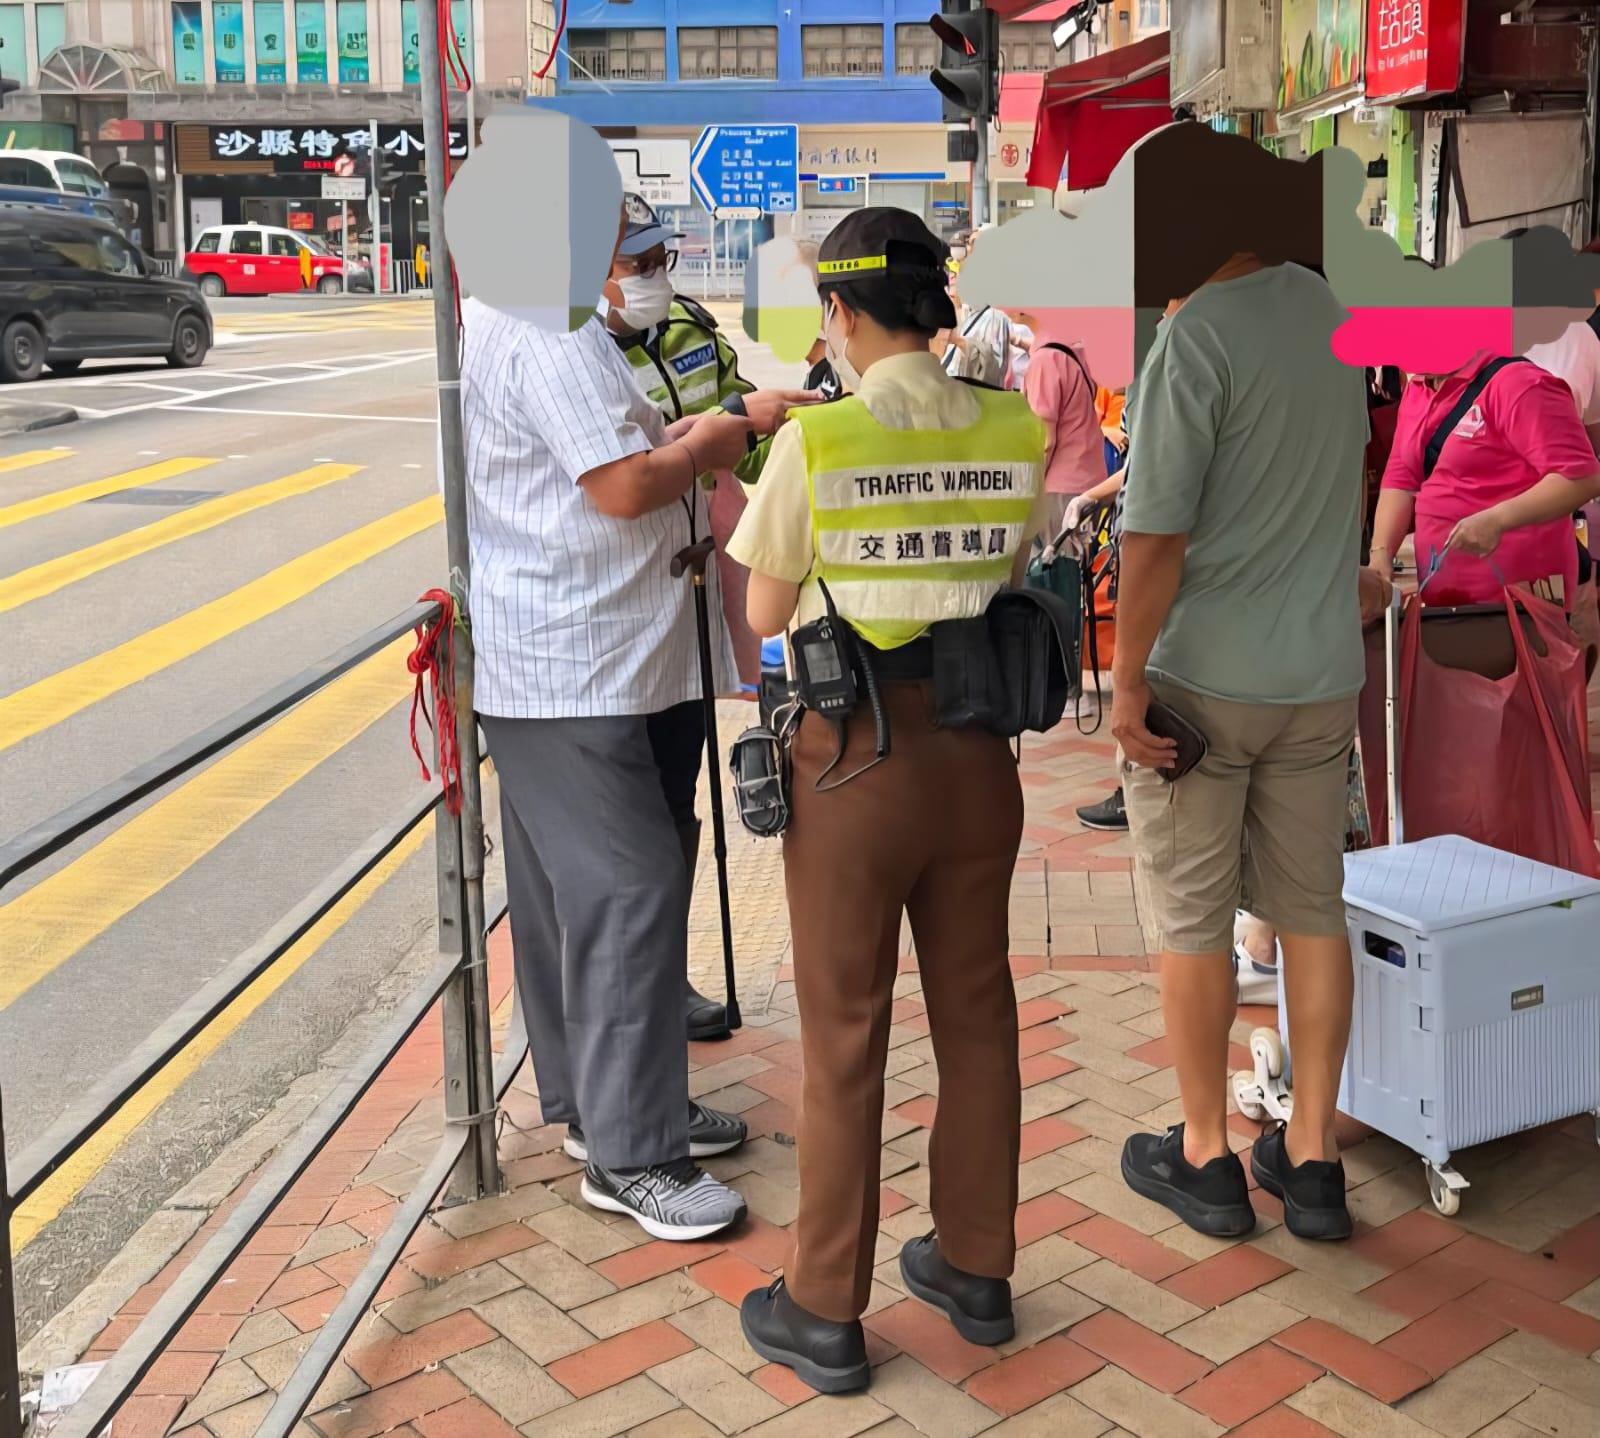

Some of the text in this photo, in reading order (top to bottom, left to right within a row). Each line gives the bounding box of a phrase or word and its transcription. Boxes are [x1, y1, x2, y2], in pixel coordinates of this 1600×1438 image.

[855, 470, 1013, 498] TRAFFIC WARDEN
[859, 527, 1007, 561] 交通督導員
